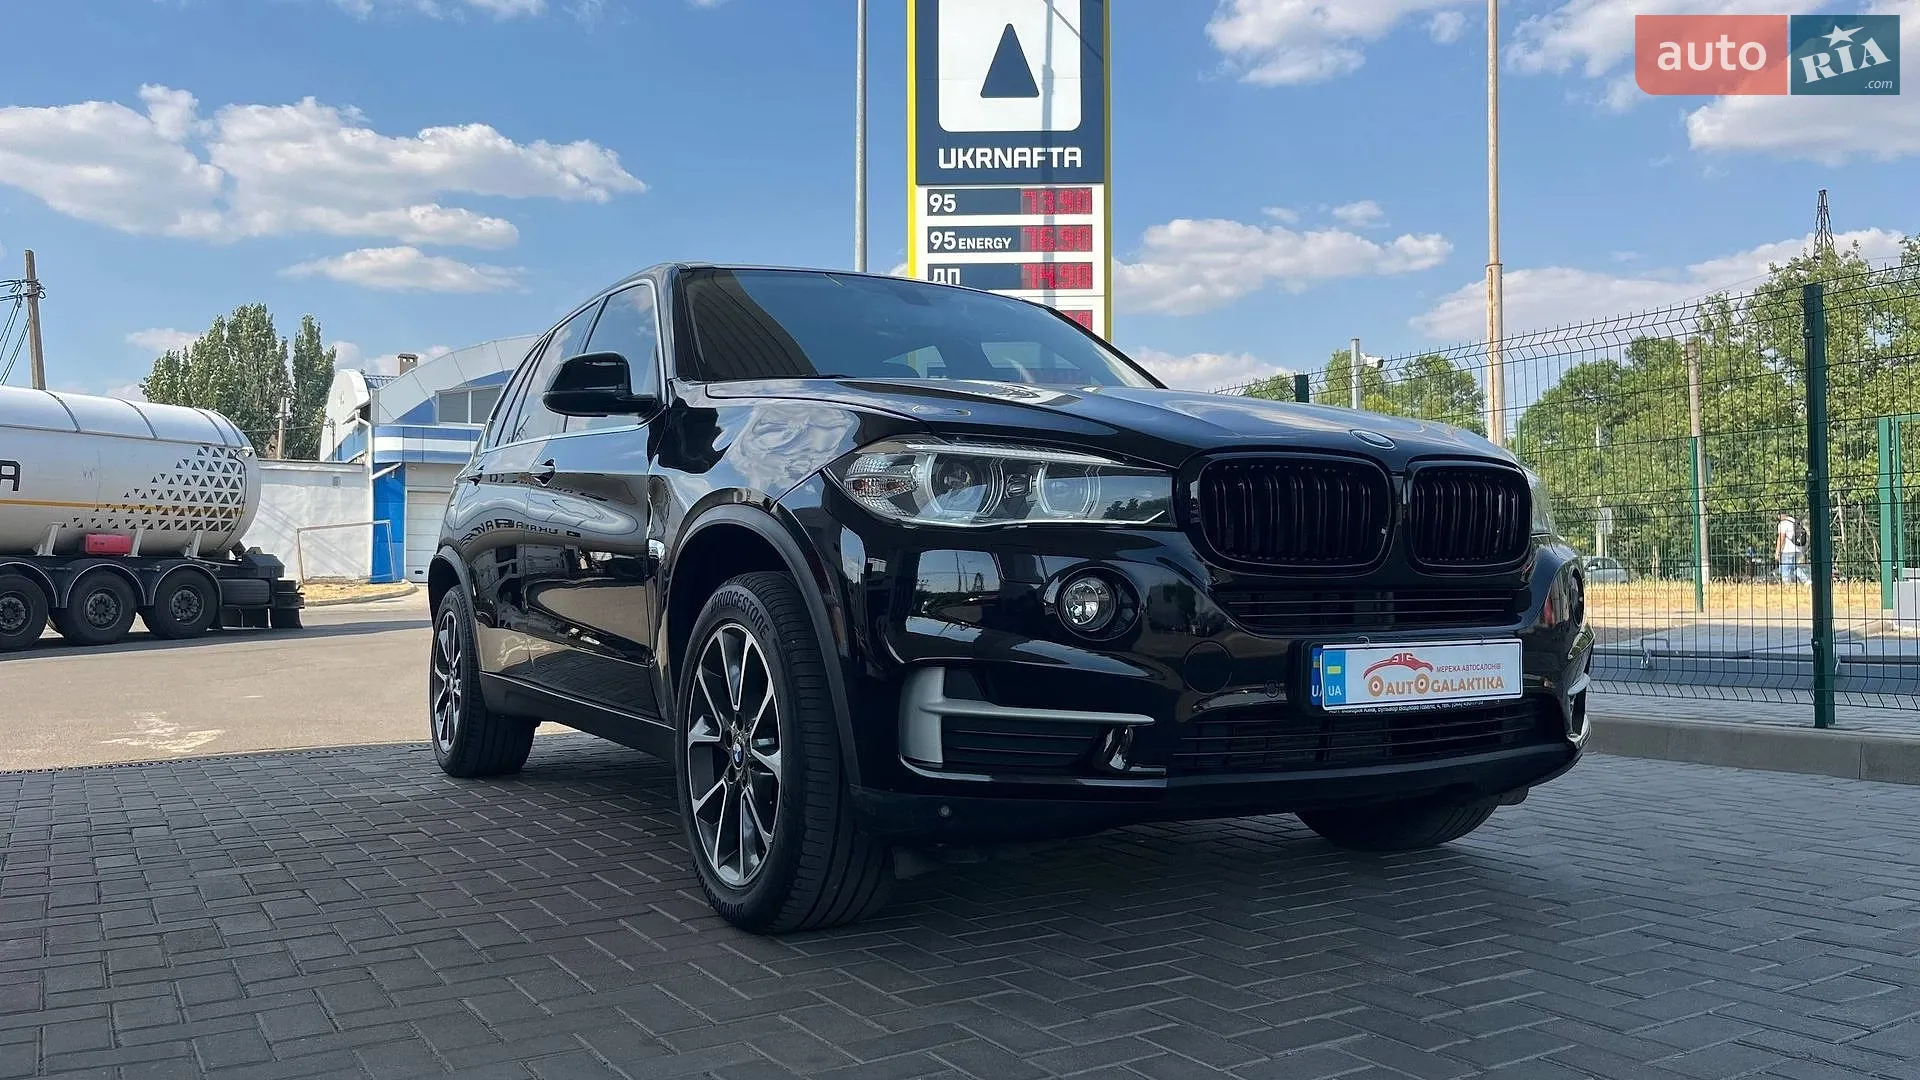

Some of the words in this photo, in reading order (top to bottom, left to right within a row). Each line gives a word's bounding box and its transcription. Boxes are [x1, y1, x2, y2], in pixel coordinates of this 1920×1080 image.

[938, 147, 1082, 169] UKRNAFTA
[929, 193, 957, 213] 95
[930, 231, 957, 250] 95
[958, 237, 1012, 249] ENERGY
[711, 590, 770, 640] BRIDGESTONE
[1312, 685, 1323, 697] U
[1328, 685, 1342, 696] UA
